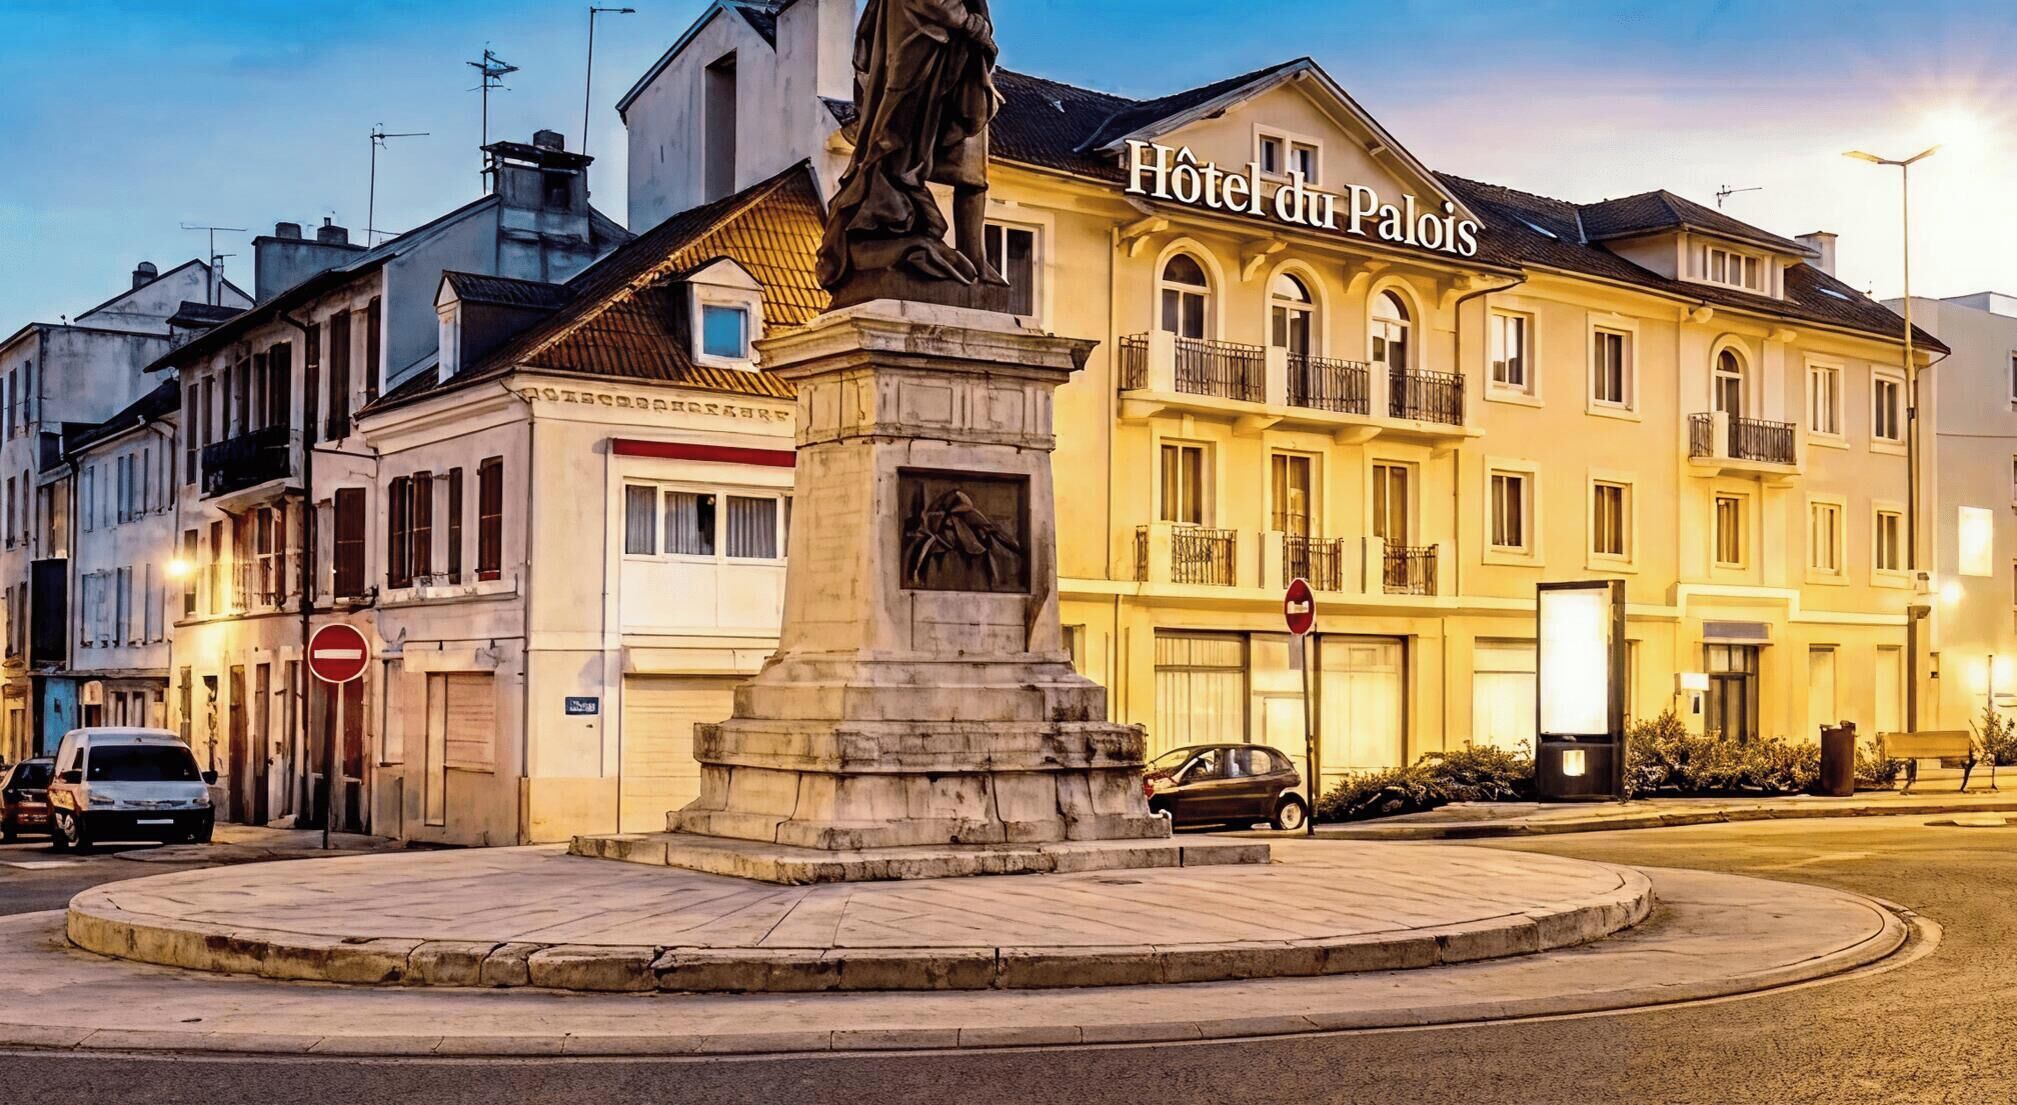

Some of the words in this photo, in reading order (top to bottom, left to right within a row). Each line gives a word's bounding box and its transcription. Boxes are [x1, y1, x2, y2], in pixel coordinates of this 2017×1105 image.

[1125, 139, 1265, 216] Hôtel
[1275, 170, 1338, 230] du
[1345, 184, 1478, 257] Palois
